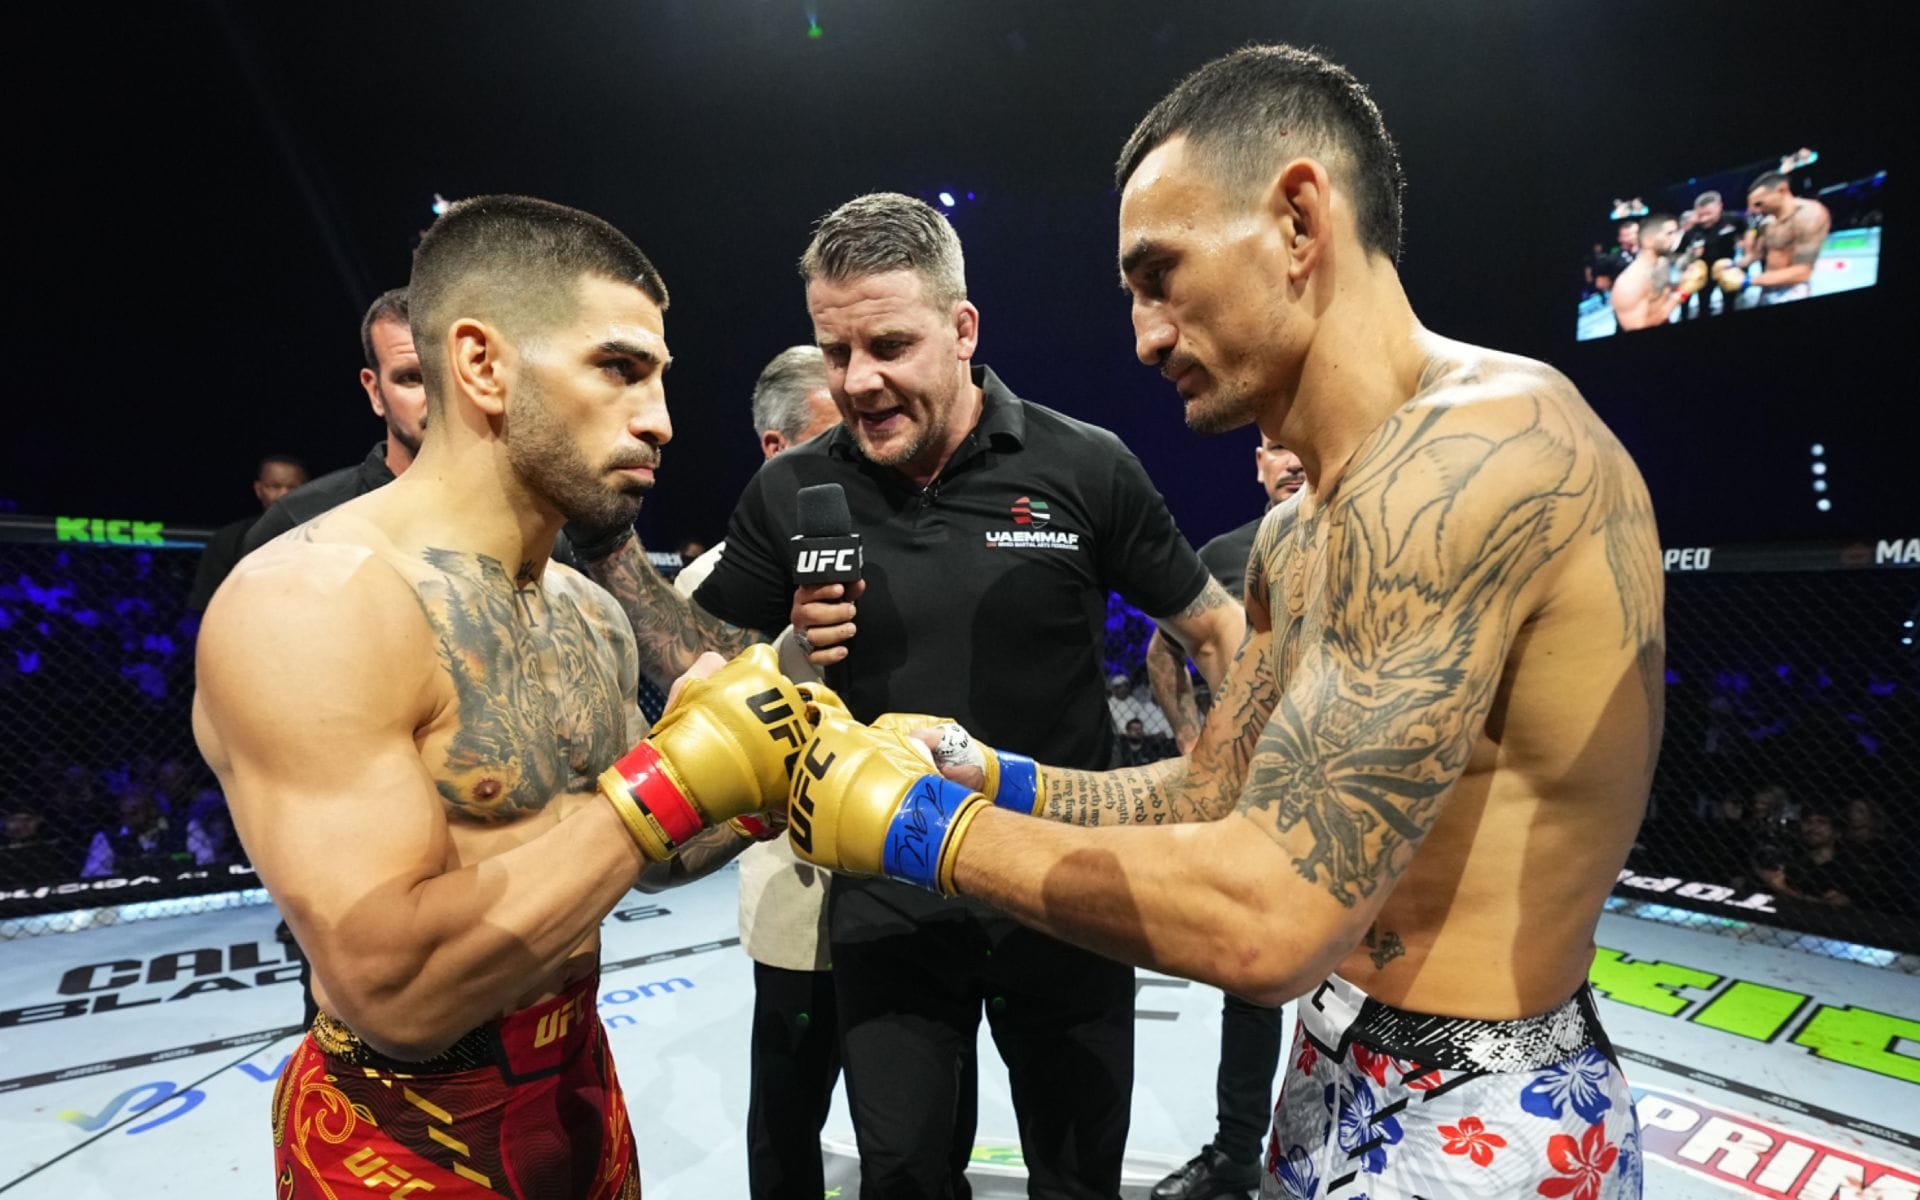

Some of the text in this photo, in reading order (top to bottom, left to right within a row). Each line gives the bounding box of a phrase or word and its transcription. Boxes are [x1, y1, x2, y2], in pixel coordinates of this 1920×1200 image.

[56, 517, 164, 547] KICK
[985, 531, 1079, 544] UAEMMAF
[796, 549, 855, 573] UFC
[1661, 547, 1713, 571] PED
[789, 737, 836, 854] UFC
[1131, 788, 1148, 823] Lord
[597, 977, 696, 1008] om
[534, 989, 588, 1048] UFC
[342, 1147, 436, 1200] UFC
